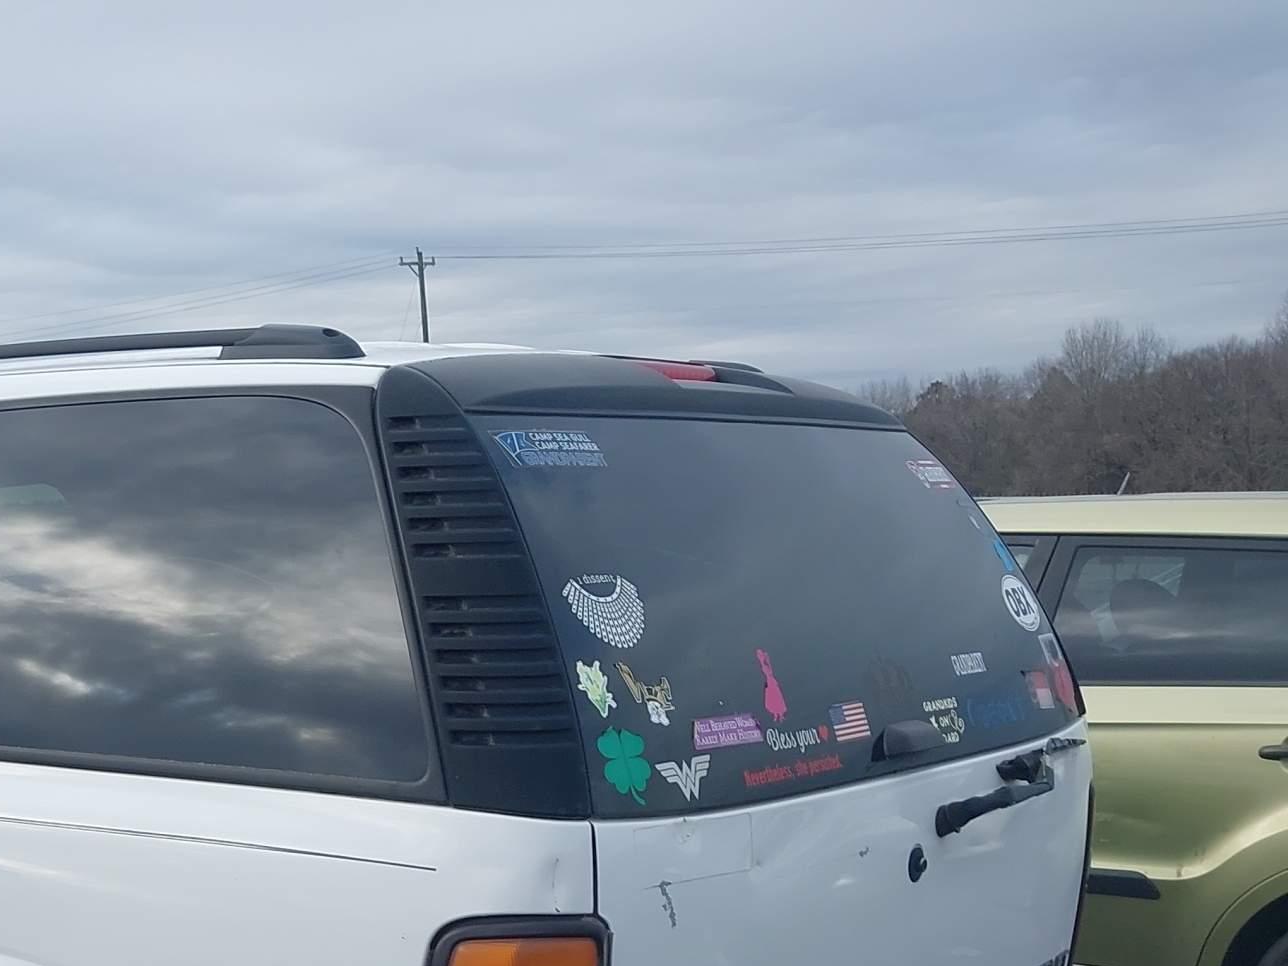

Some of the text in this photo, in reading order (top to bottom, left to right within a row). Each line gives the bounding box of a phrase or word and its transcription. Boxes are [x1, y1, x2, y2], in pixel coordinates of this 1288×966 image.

[528, 432, 552, 441] CAMP
[553, 433, 570, 441] SEA
[534, 442, 559, 450] CAMP
[582, 573, 617, 585] dissent
[1004, 586, 1036, 618] OBX
[922, 696, 958, 713] GRANDKIDS
[766, 726, 821, 753] Bless your
